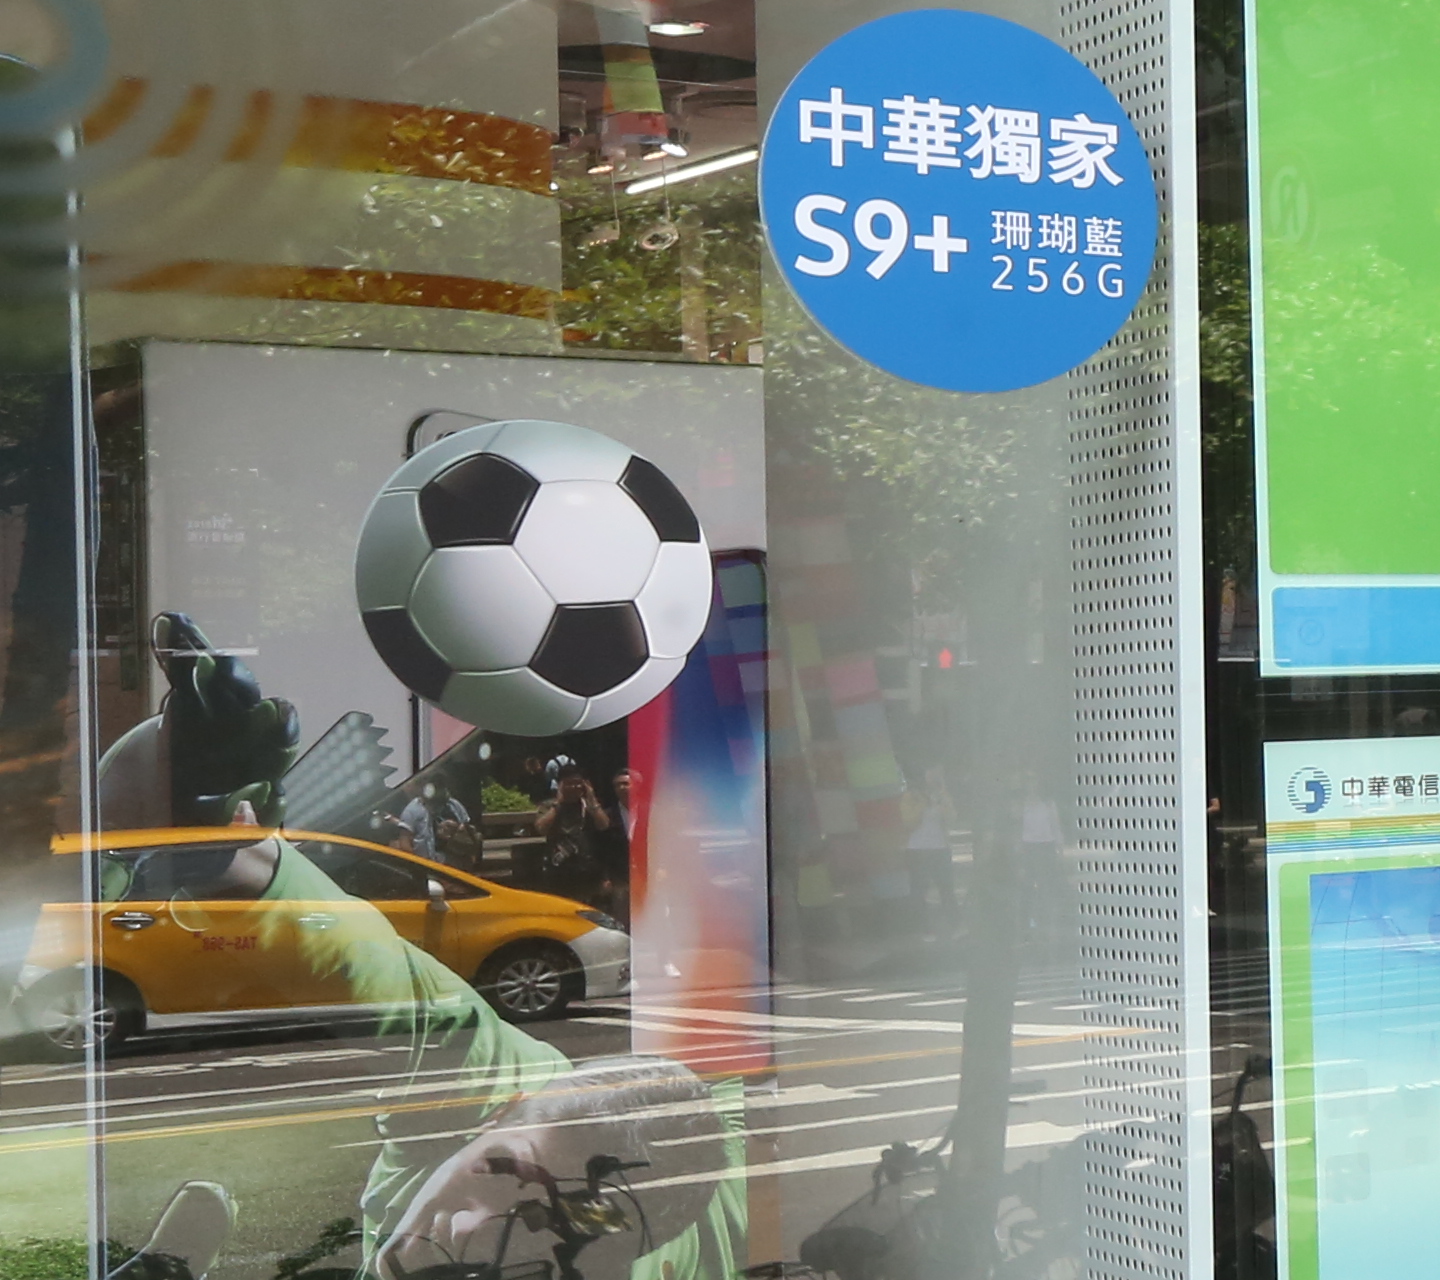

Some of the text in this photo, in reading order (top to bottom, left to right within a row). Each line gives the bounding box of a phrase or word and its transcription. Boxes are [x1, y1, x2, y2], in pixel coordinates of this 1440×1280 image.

[795, 88, 1124, 191] 中華獨家
[793, 195, 968, 282] S9+
[991, 208, 1124, 260] 珊瑚藍
[990, 254, 1124, 302] 256G
[1341, 773, 1440, 800] 中華電信
